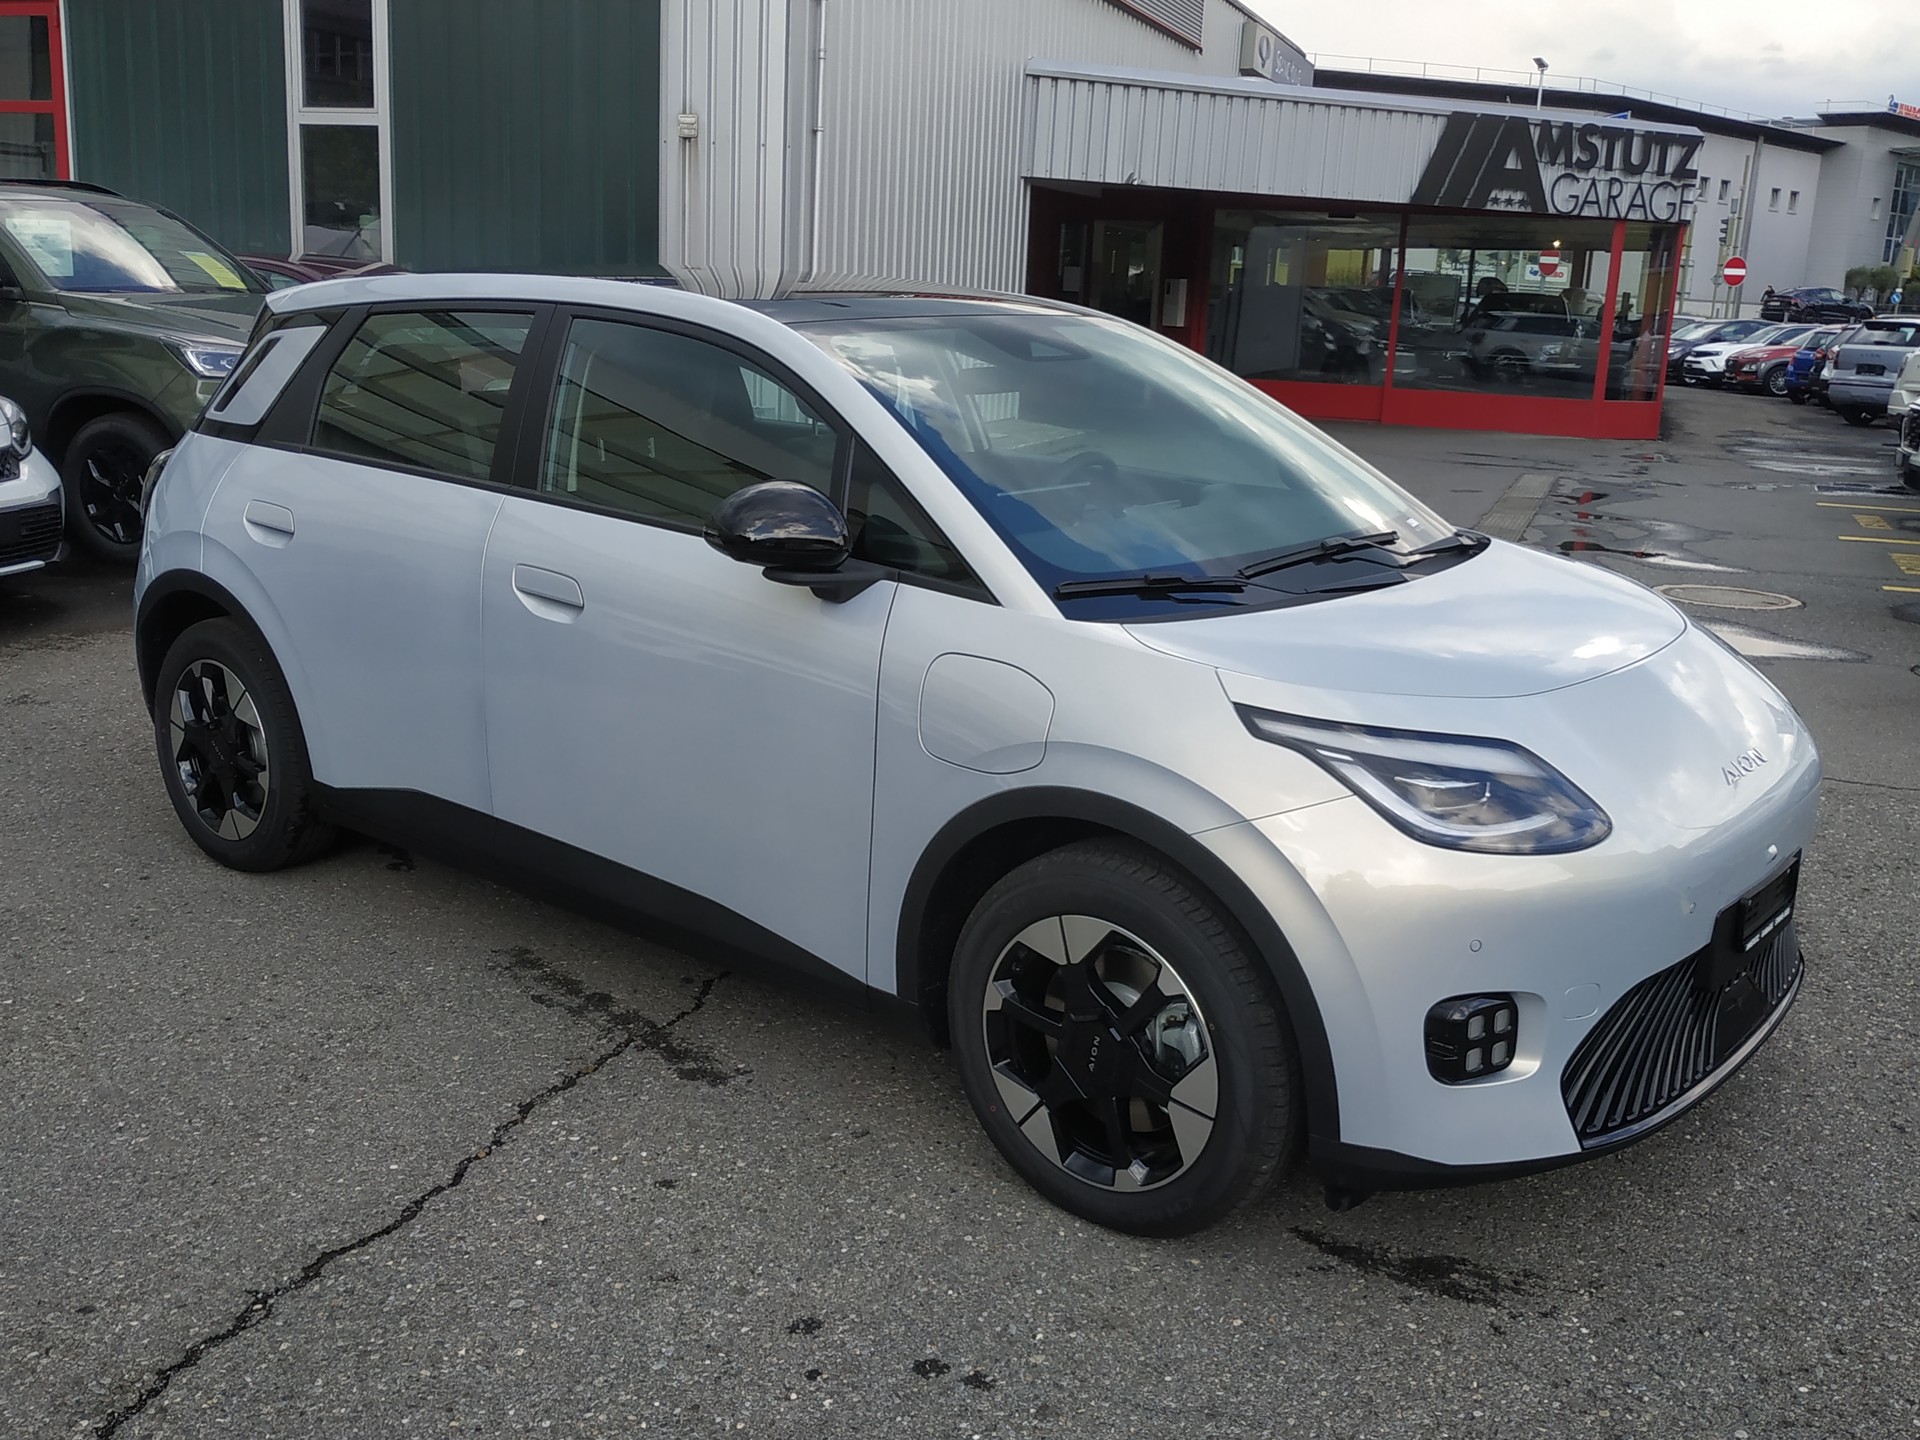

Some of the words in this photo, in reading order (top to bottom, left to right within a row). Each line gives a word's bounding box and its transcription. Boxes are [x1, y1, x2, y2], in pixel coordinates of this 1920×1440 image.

[1464, 115, 1704, 213] AMSTUTZ
[1550, 172, 1697, 224] GARAGE
[1721, 746, 1767, 786] AION
[1088, 1035, 1100, 1072] AION
